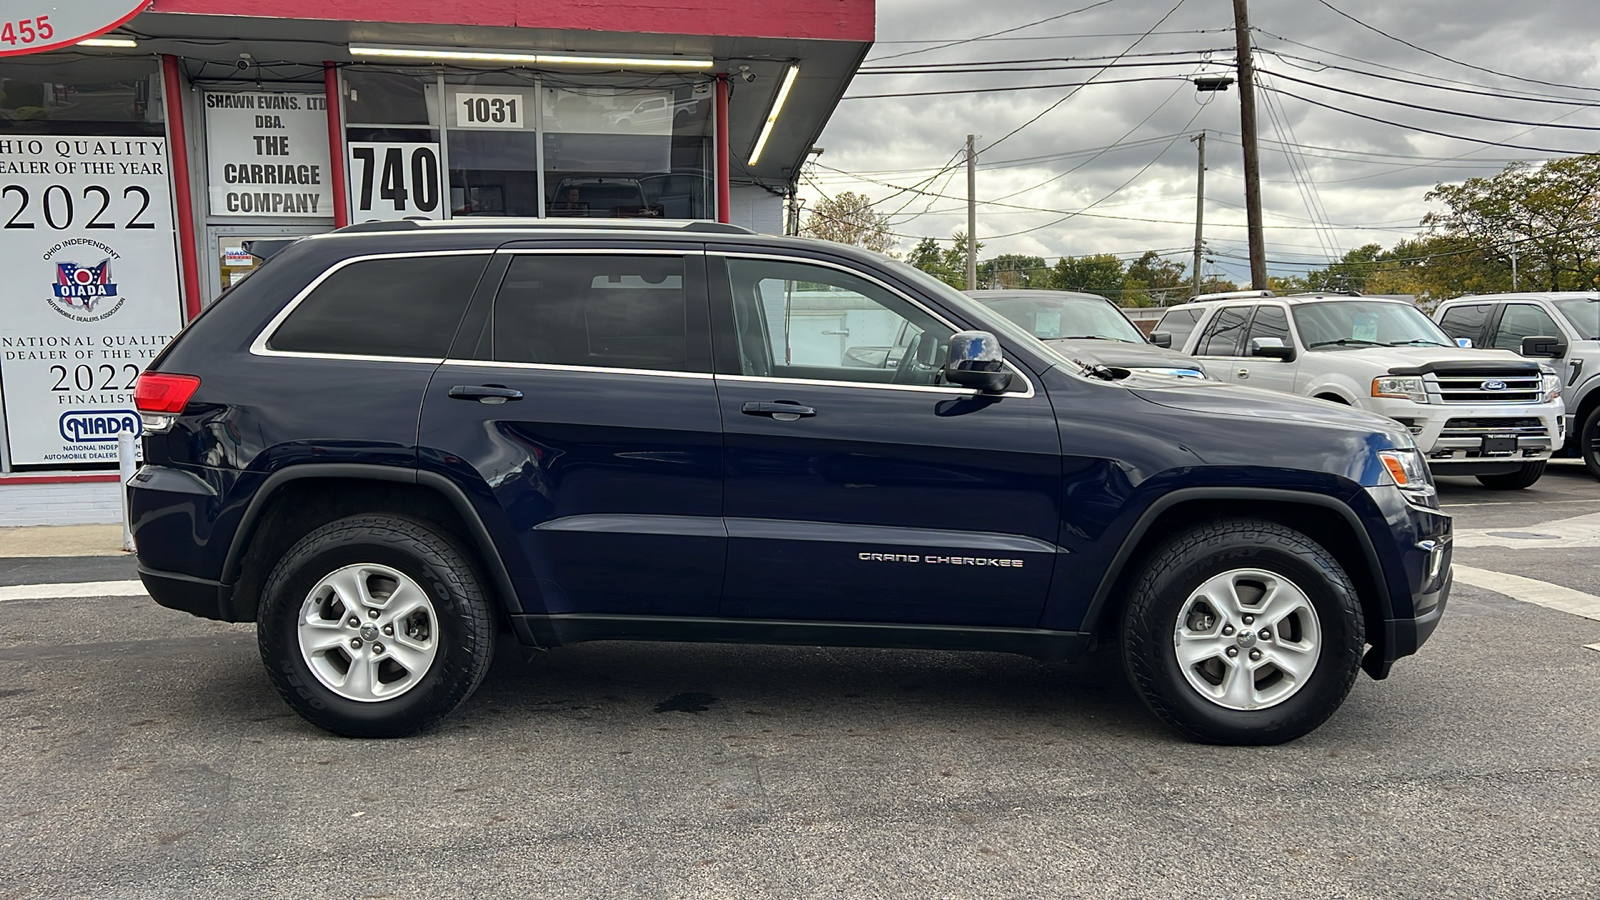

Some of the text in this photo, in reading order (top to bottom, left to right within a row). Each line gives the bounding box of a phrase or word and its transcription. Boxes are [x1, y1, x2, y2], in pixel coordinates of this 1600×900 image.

[1, 16, 54, 45] 455
[206, 94, 254, 109] SHAWN
[258, 96, 301, 110] EVANS.
[463, 97, 517, 123] 1031
[255, 115, 285, 129] DBA.
[56, 141, 163, 158] QUALITY
[253, 136, 289, 156] THE
[55, 162, 76, 174] OF
[81, 162, 115, 175] THE
[119, 163, 163, 175] YEAR
[224, 163, 320, 185] CARRIAGE
[353, 147, 439, 212] 740
[2, 185, 156, 230] 2022
[226, 192, 320, 213] COMPANY
[43, 238, 121, 260] OHIO INDEPENDENT
[61, 285, 107, 297] OIADA
[46, 298, 75, 320] AUTOMOBILE
[100, 297, 126, 320] ASSOCIATION
[3, 336, 174, 347] NATIONAL QUALIT
[6, 351, 67, 360] DEALER
[75, 350, 94, 359] OF
[101, 350, 131, 359] THE
[50, 364, 139, 391] 2022
[58, 394, 134, 404] FINALIST
[65, 415, 135, 440] NIADA
[858, 552, 1024, 567] GRAND CHEROKEE
